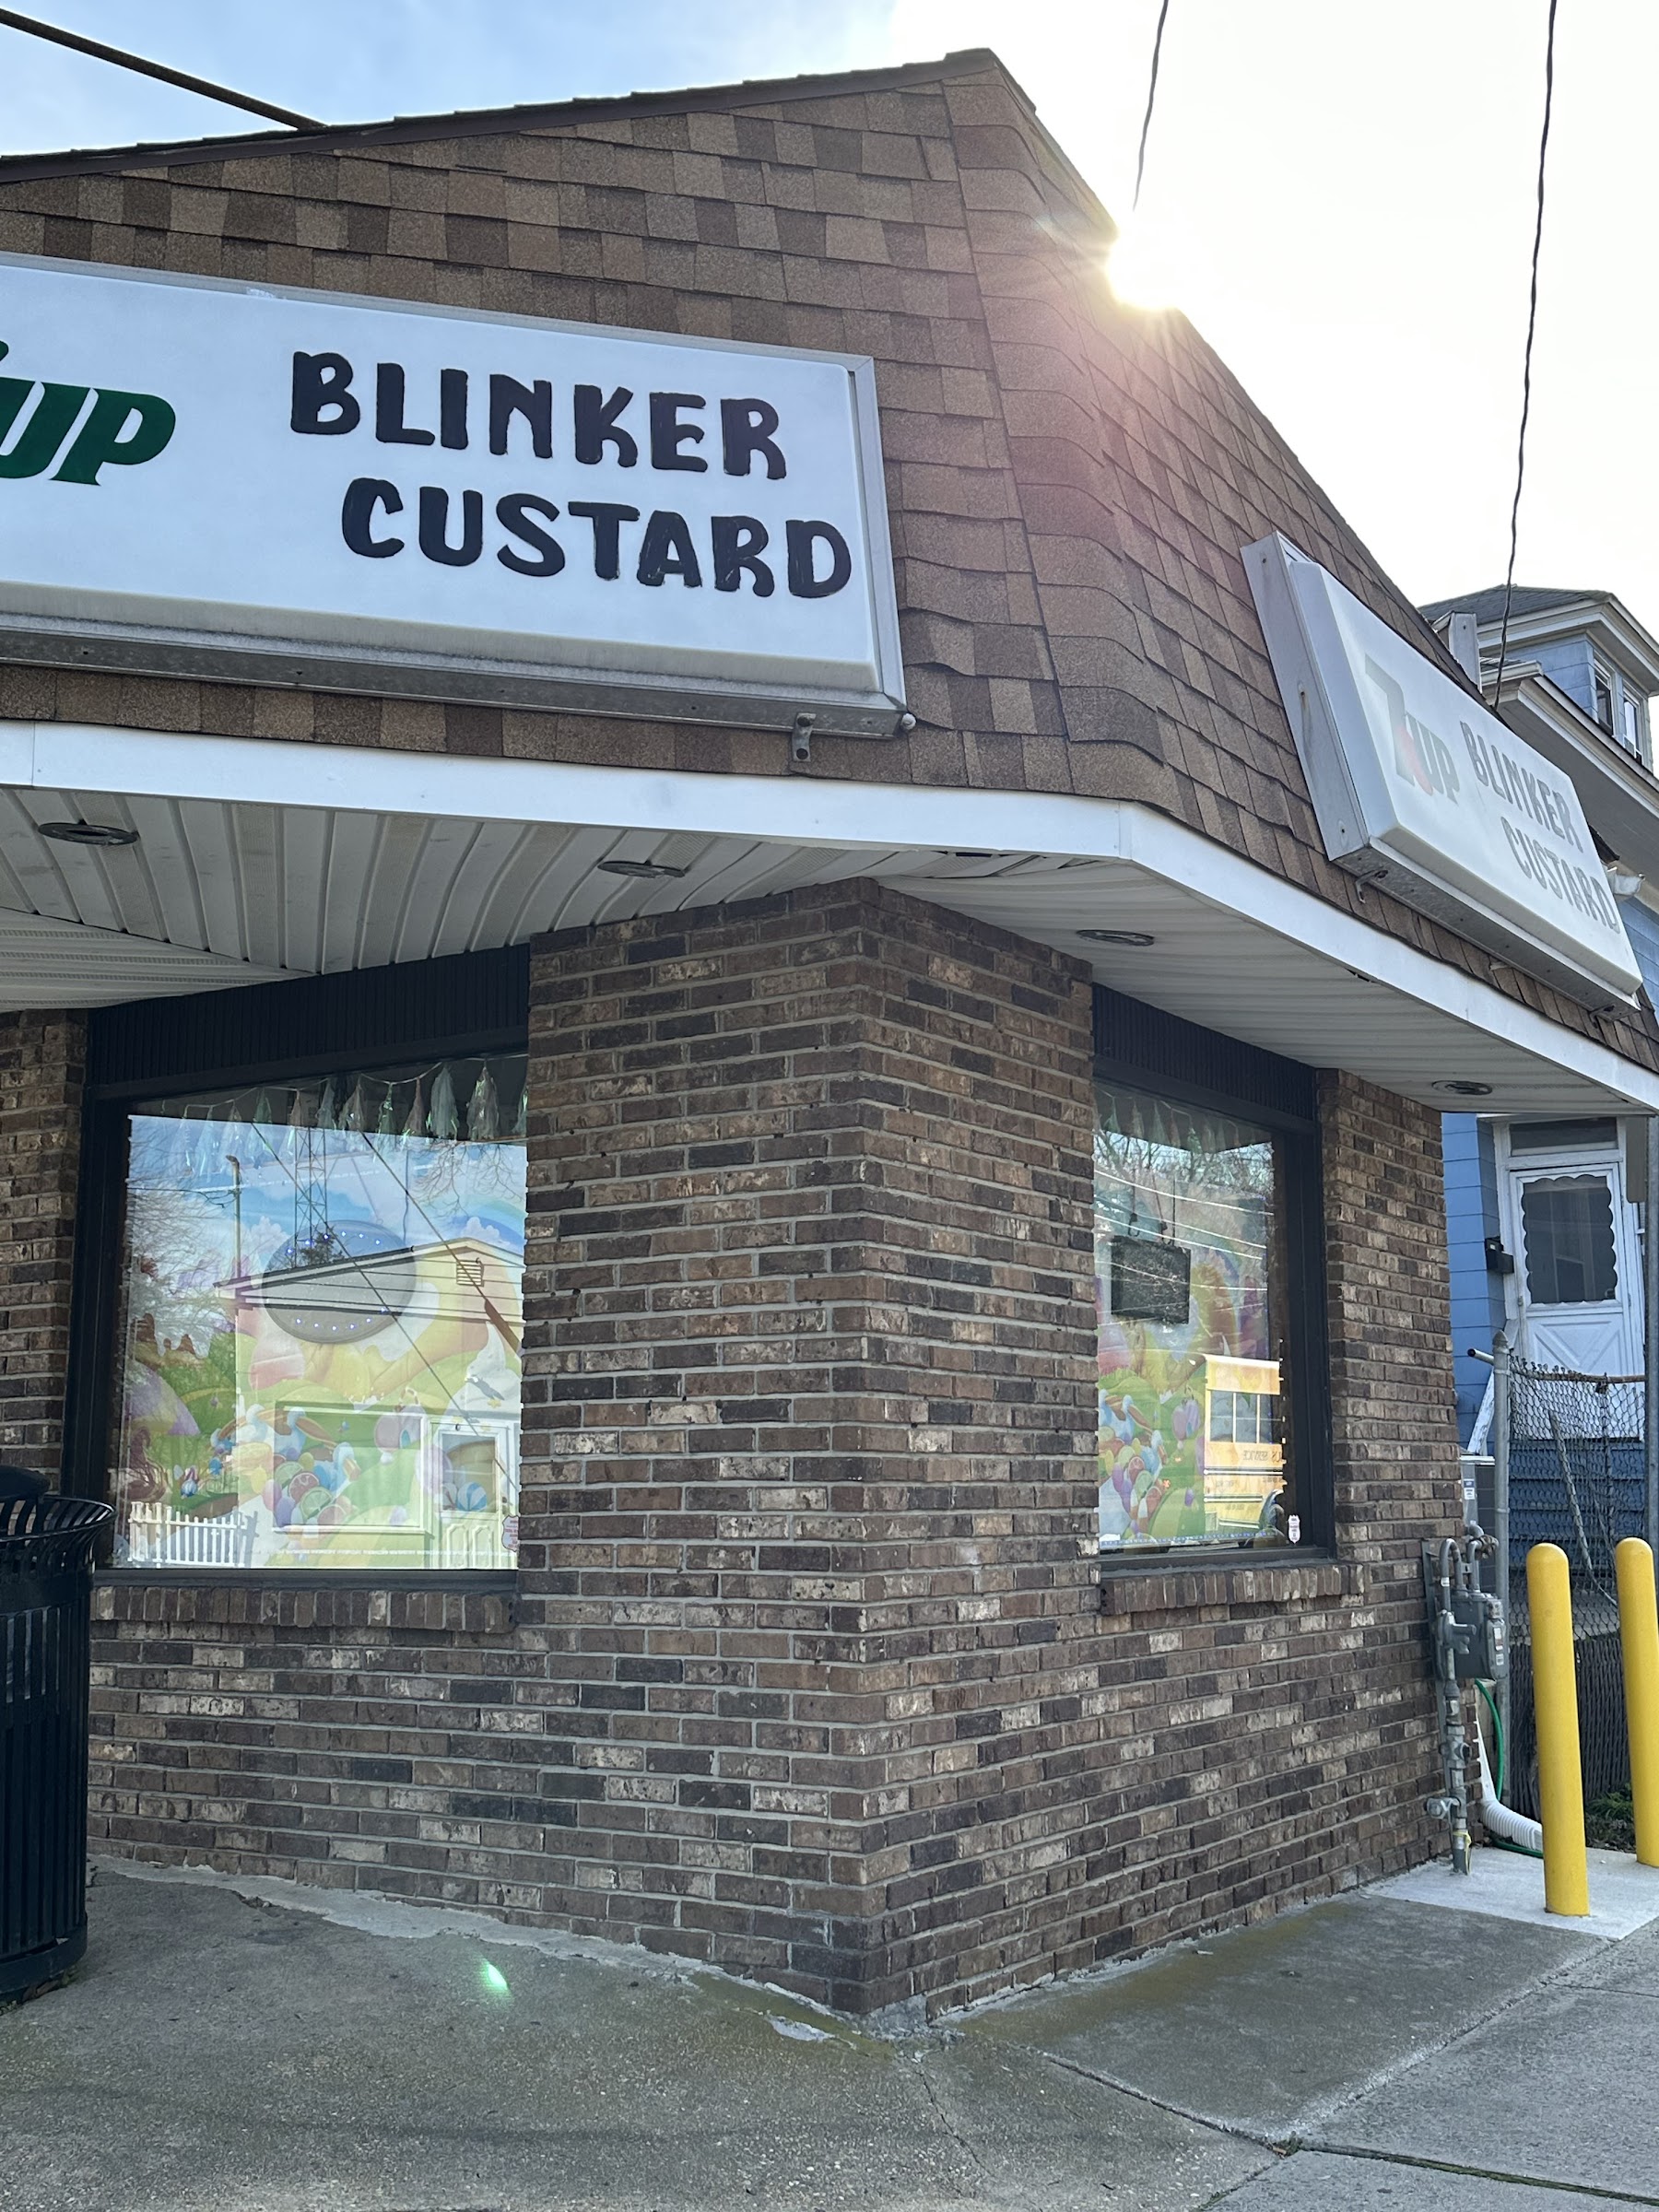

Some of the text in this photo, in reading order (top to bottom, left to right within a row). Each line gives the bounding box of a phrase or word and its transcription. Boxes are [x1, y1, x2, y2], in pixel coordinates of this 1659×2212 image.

[0, 339, 787, 486] UP BLINKER
[342, 477, 853, 598] CUSTARD
[1459, 720, 1583, 853] BLINKER
[1500, 816, 1620, 934] CUSTARD
